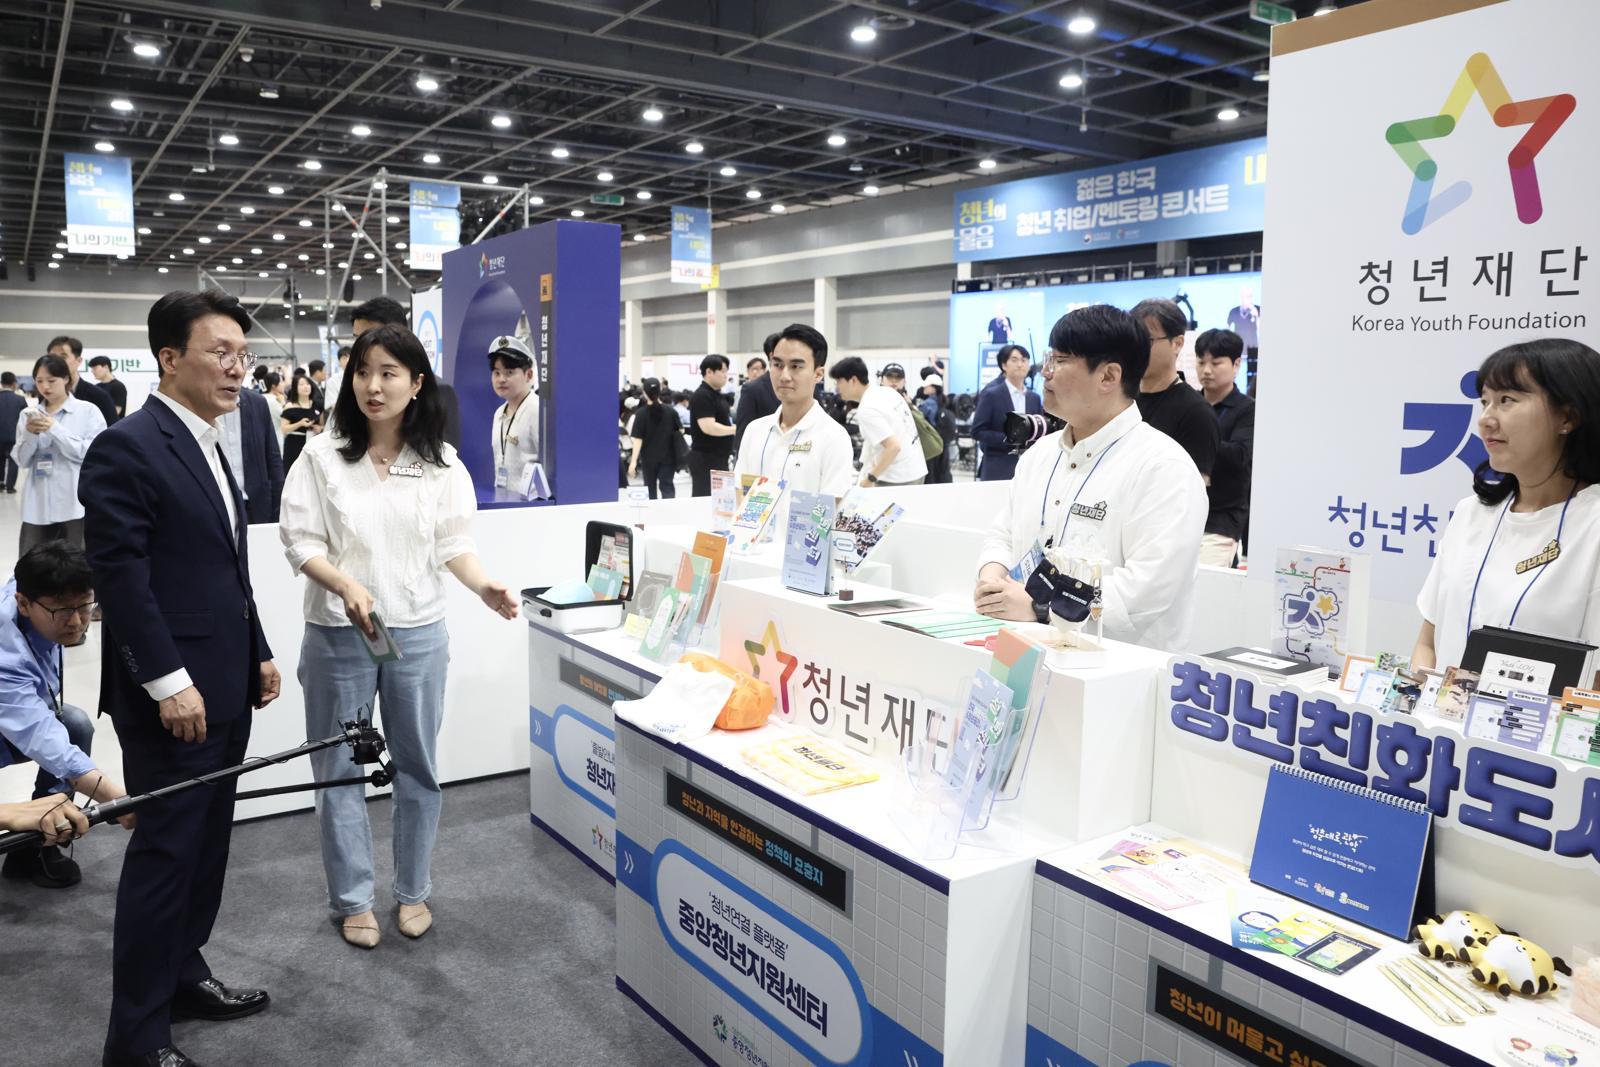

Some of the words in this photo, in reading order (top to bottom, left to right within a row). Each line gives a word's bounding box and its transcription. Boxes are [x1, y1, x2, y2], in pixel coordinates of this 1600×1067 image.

[960, 198, 1007, 226] 청년의
[1016, 210, 1051, 237] 청년
[1054, 194, 1159, 233] 취업/멘토링
[1162, 184, 1229, 219] 콘서트
[1076, 172, 1114, 202] 젊은
[1117, 167, 1156, 195] 한국
[1358, 246, 1588, 306] 청년재단
[1352, 315, 1405, 332] Korea
[1411, 315, 1463, 332] Youth
[1468, 312, 1587, 331] Foundation
[681, 791, 704, 816] 청년과
[730, 819, 764, 850] 연결하는
[765, 839, 792, 869] 정책의
[679, 898, 828, 1038] 중앙청년지원센터
[1169, 987, 1222, 1032] 청년이
[1226, 1016, 1284, 1064] 머물고
